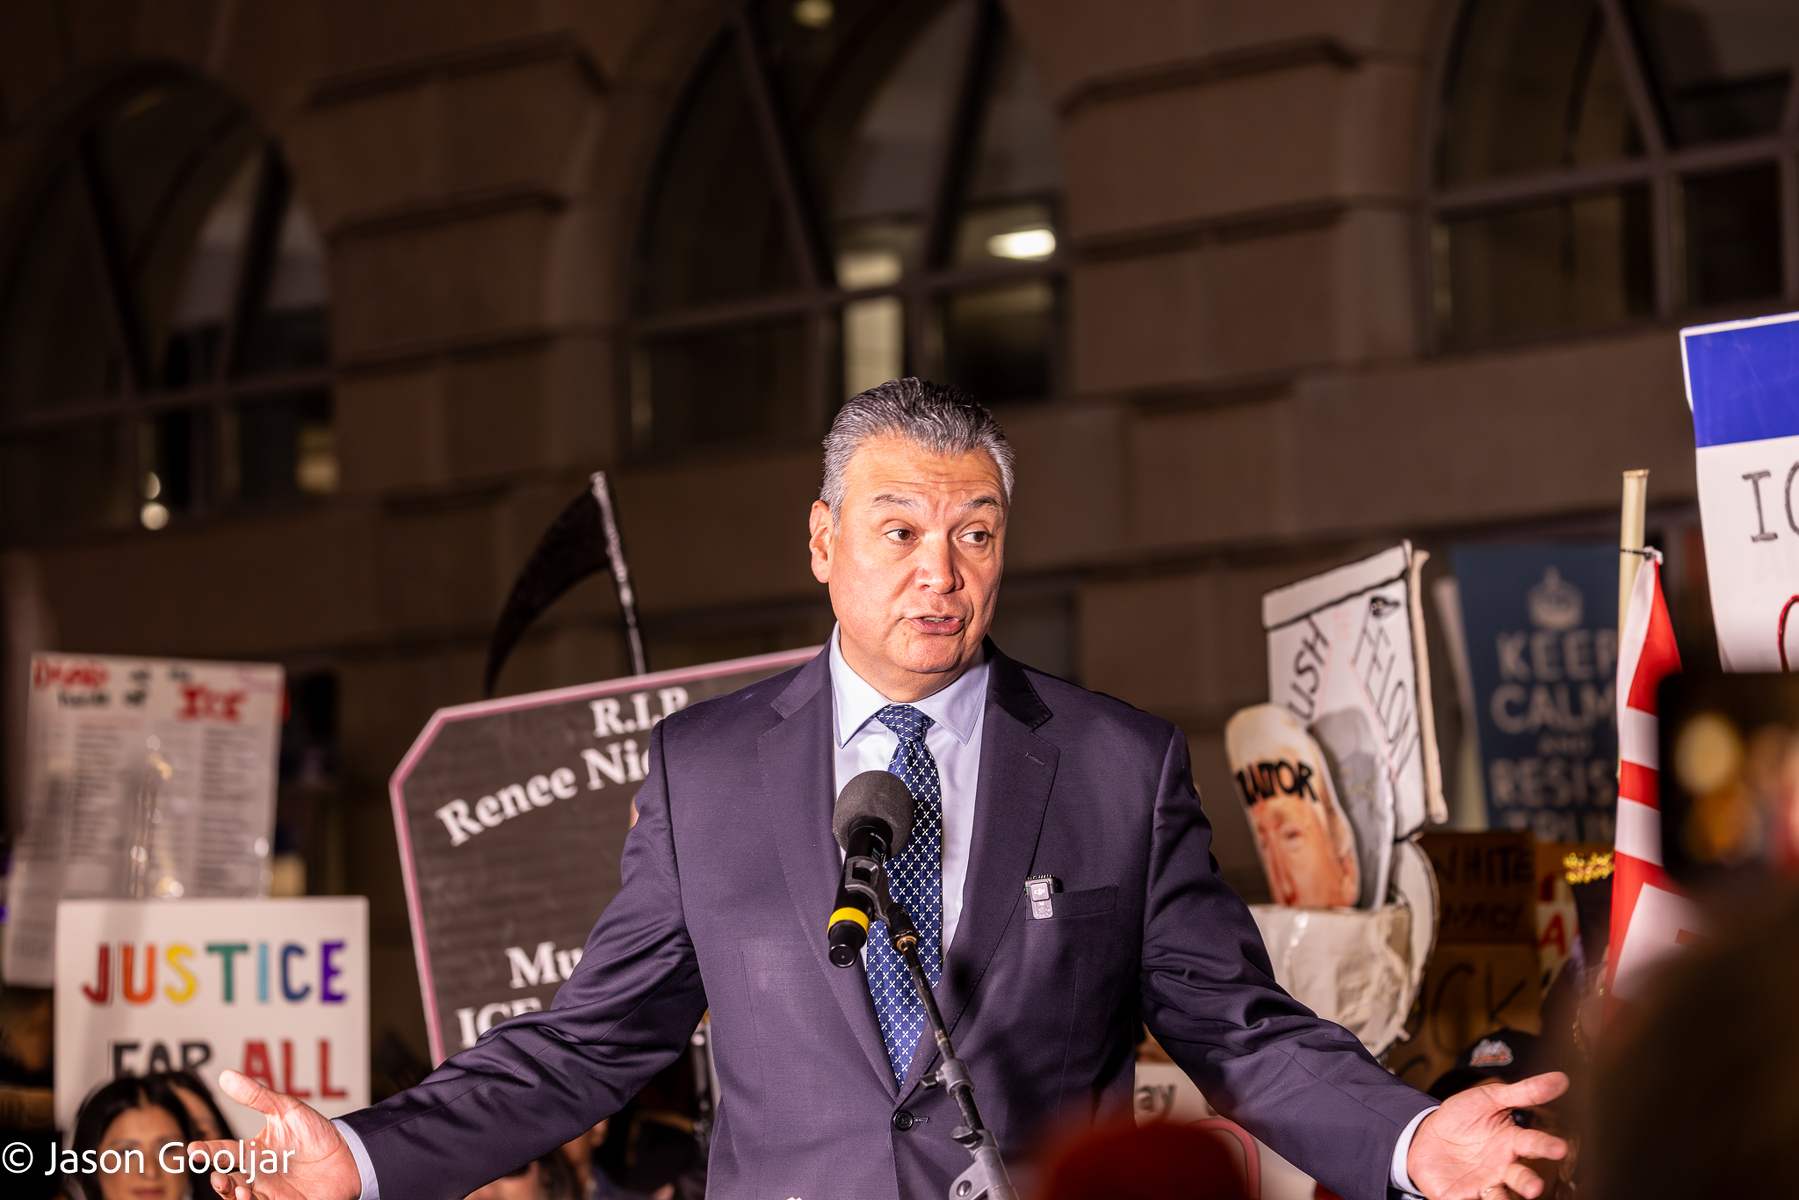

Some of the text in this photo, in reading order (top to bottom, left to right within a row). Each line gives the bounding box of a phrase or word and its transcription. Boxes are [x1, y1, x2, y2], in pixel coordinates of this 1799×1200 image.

[1496, 628, 1618, 682] KEEP
[435, 767, 579, 846] Renee
[81, 940, 347, 1006] JUSTICE
[241, 1038, 347, 1099] ALL
